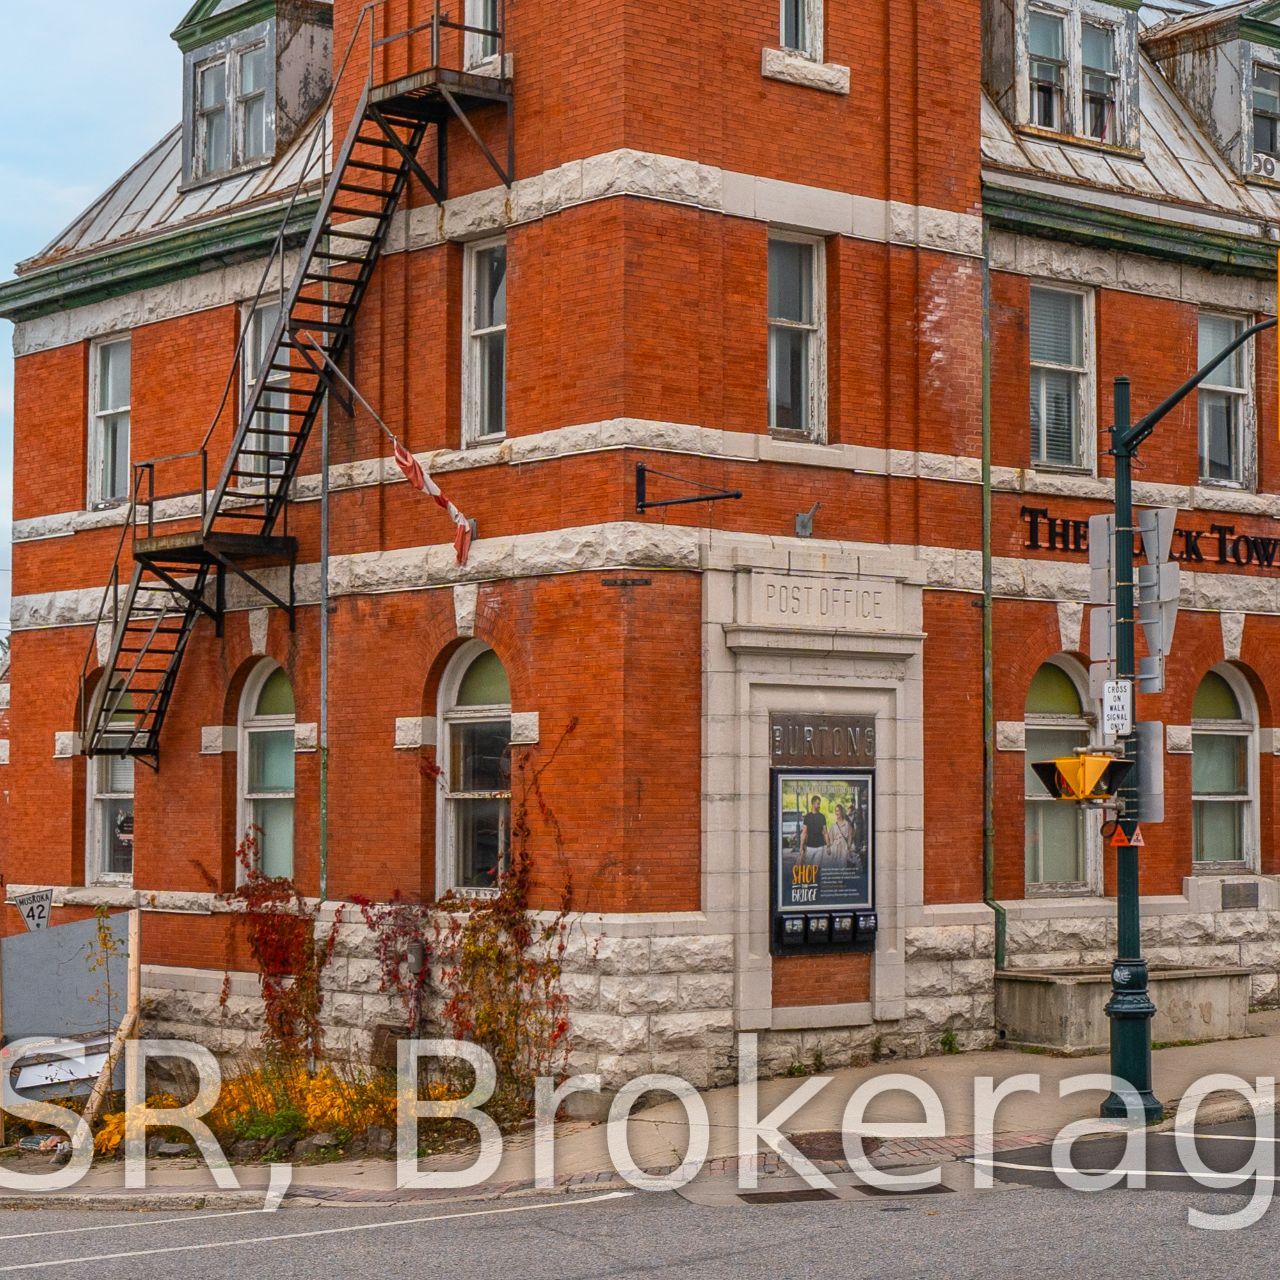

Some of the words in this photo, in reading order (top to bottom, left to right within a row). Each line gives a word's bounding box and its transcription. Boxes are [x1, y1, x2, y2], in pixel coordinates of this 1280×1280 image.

[766, 584, 813, 614] POST
[819, 588, 883, 619] OFFICE
[1107, 685, 1128, 694] CROSS
[1109, 704, 1125, 712] WALK
[1106, 713, 1128, 721] SIGNAL
[771, 725, 875, 757] BURTONS
[791, 864, 819, 885] SHOP
[791, 888, 818, 903] BRIDGE
[26, 904, 47, 921] 42
